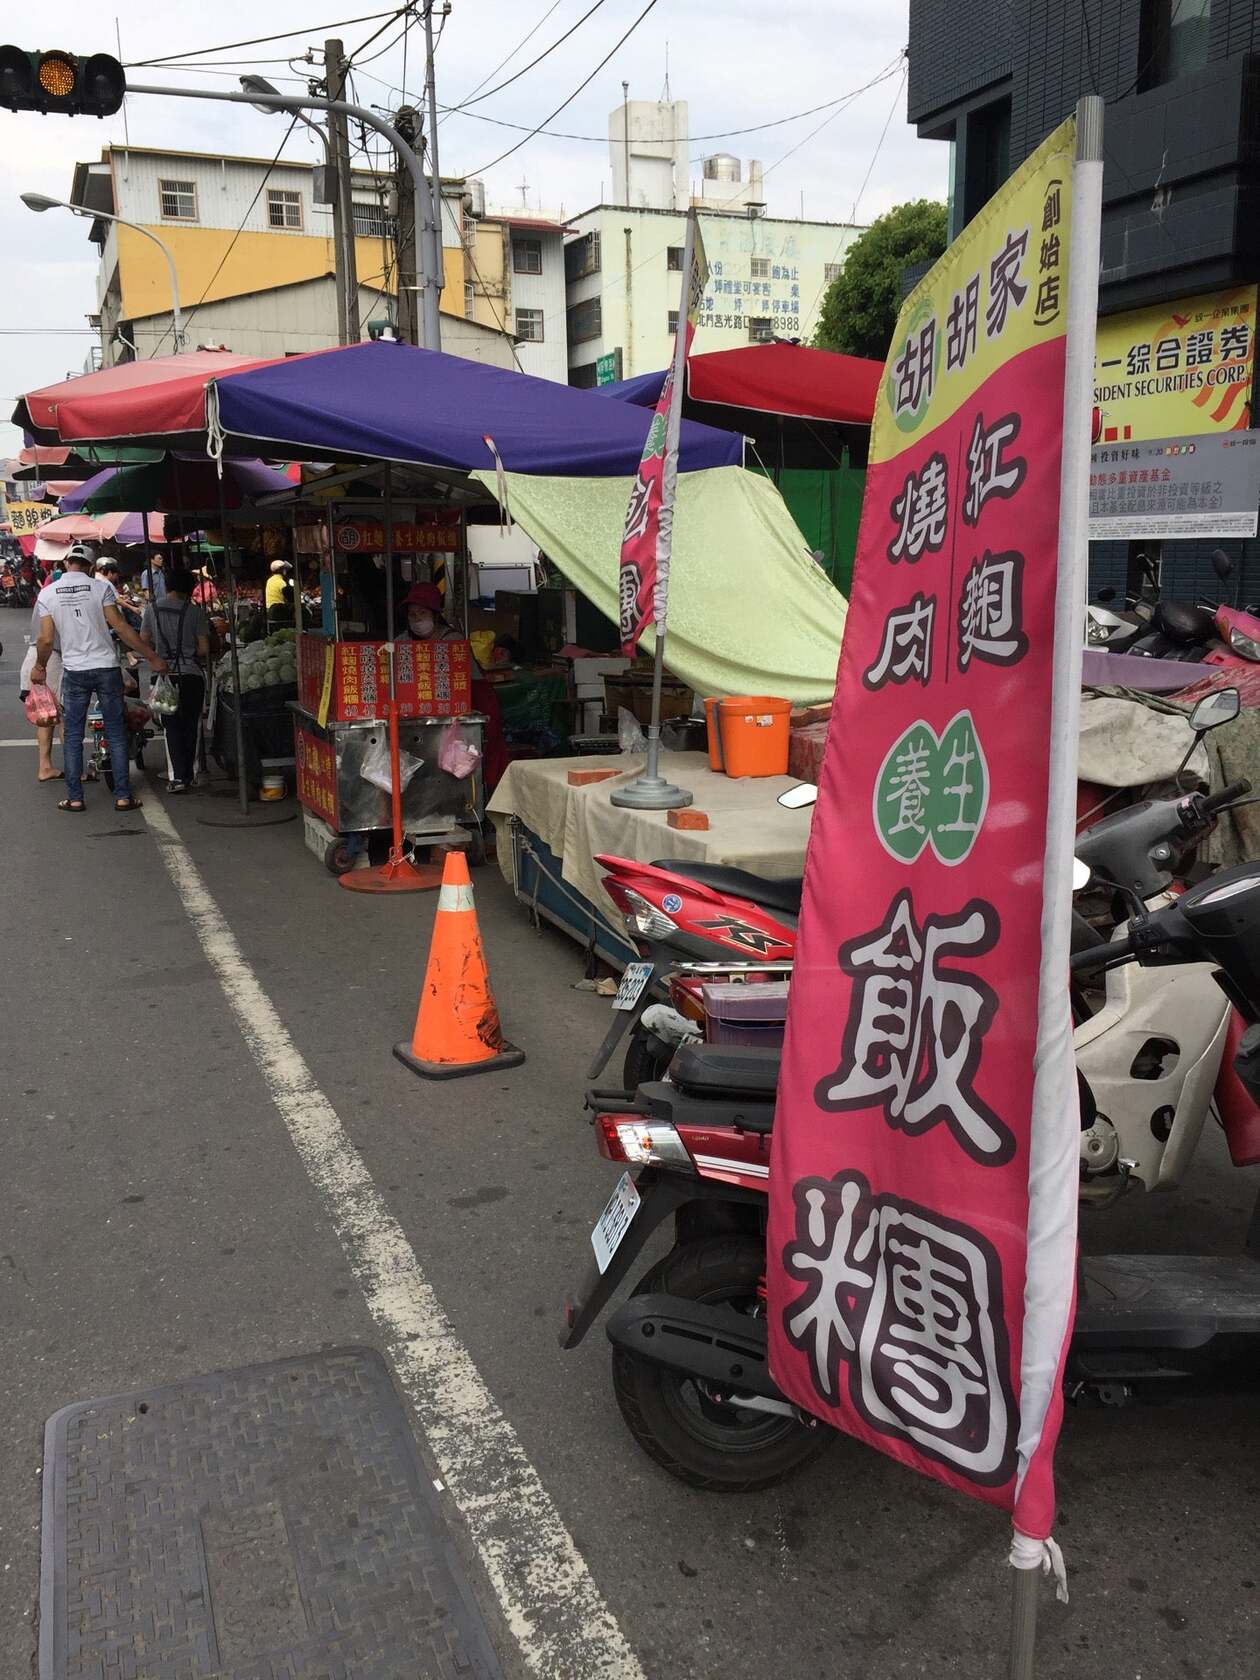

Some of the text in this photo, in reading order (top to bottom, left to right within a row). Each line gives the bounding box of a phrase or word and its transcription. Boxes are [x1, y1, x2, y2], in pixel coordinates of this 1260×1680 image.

[896, 229, 1030, 417] 胡胡家
[1094, 325, 1249, 376] 一綜合證券
[1134, 371, 1203, 397] SECURITIES
[1206, 365, 1246, 386] CORP.
[865, 457, 948, 688] 燒肉
[886, 731, 978, 835] 養生
[787, 895, 1014, 1480] 飯糰
